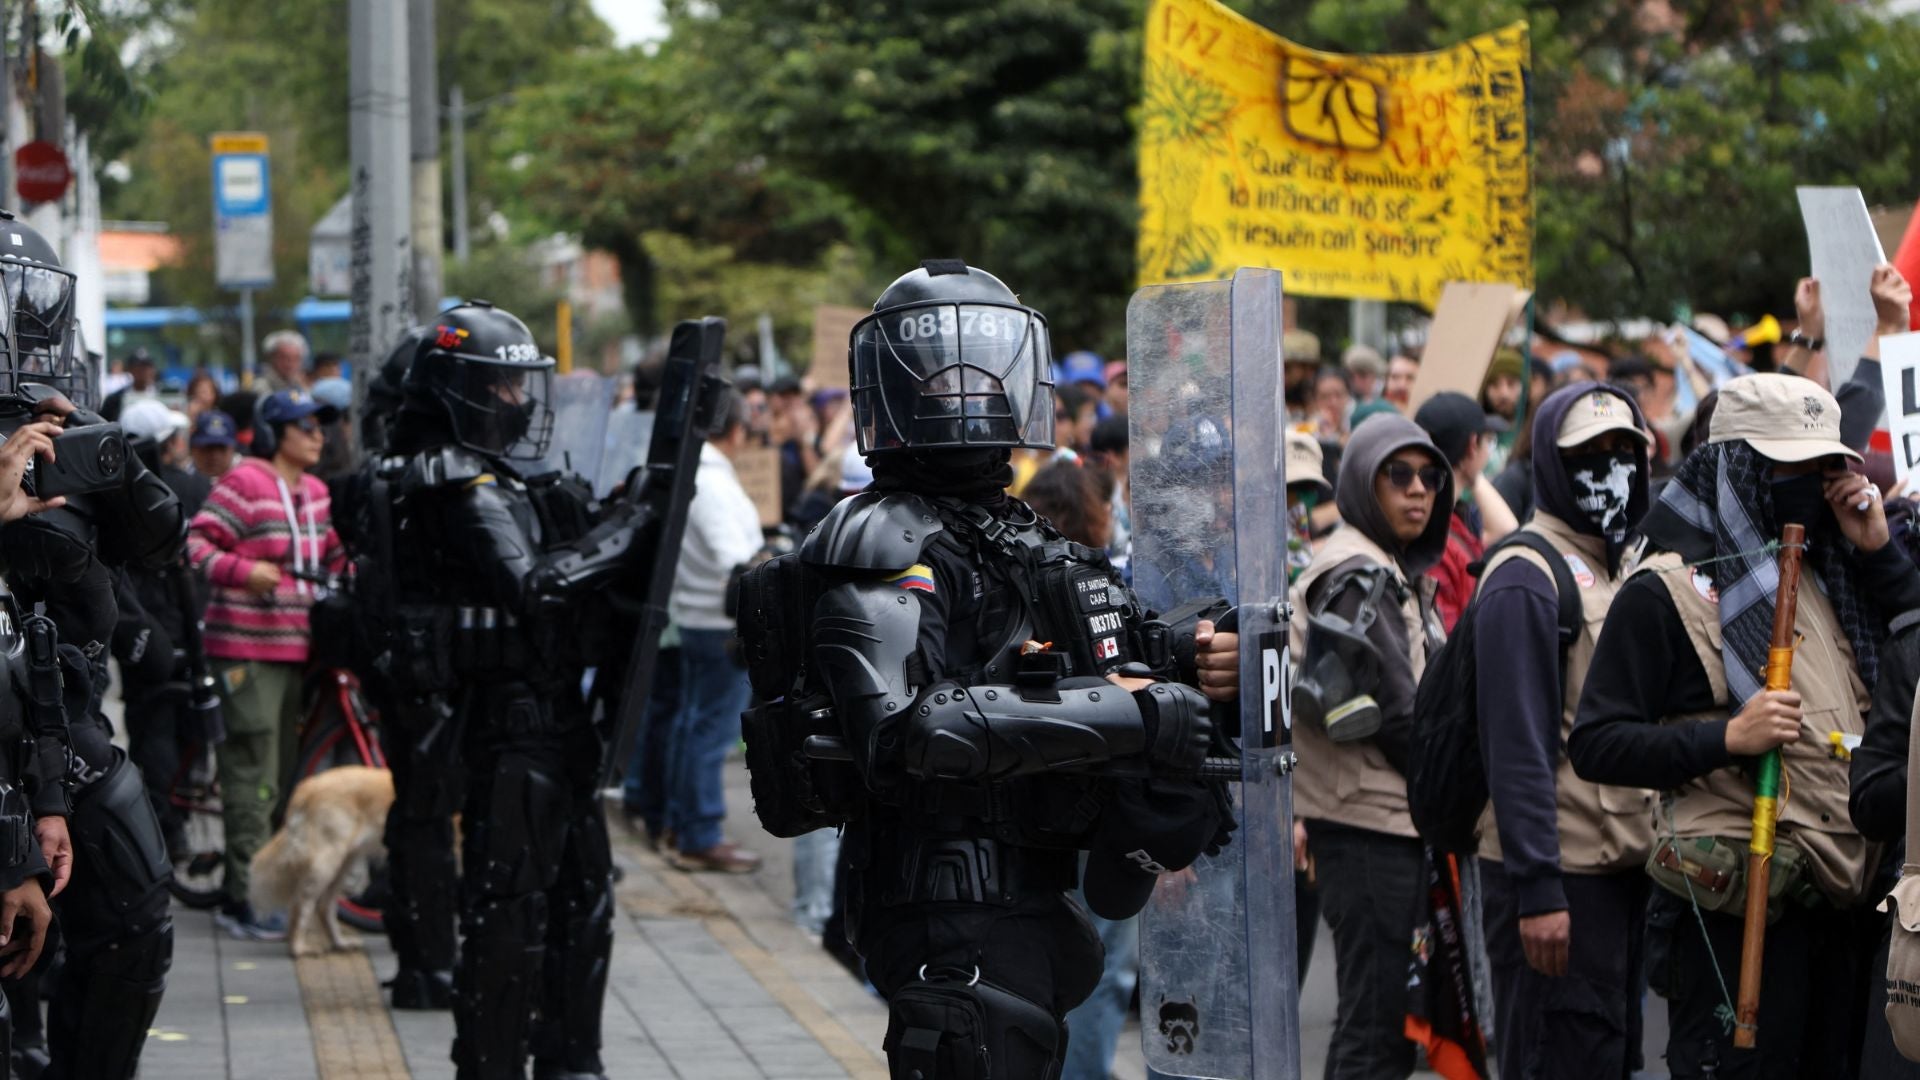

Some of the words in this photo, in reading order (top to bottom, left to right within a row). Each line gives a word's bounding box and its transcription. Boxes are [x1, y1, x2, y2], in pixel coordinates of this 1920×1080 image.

[900, 312, 1014, 342] 083781
[1087, 577, 1110, 591] SANTIAGO
[1089, 611, 1122, 634] 083781
